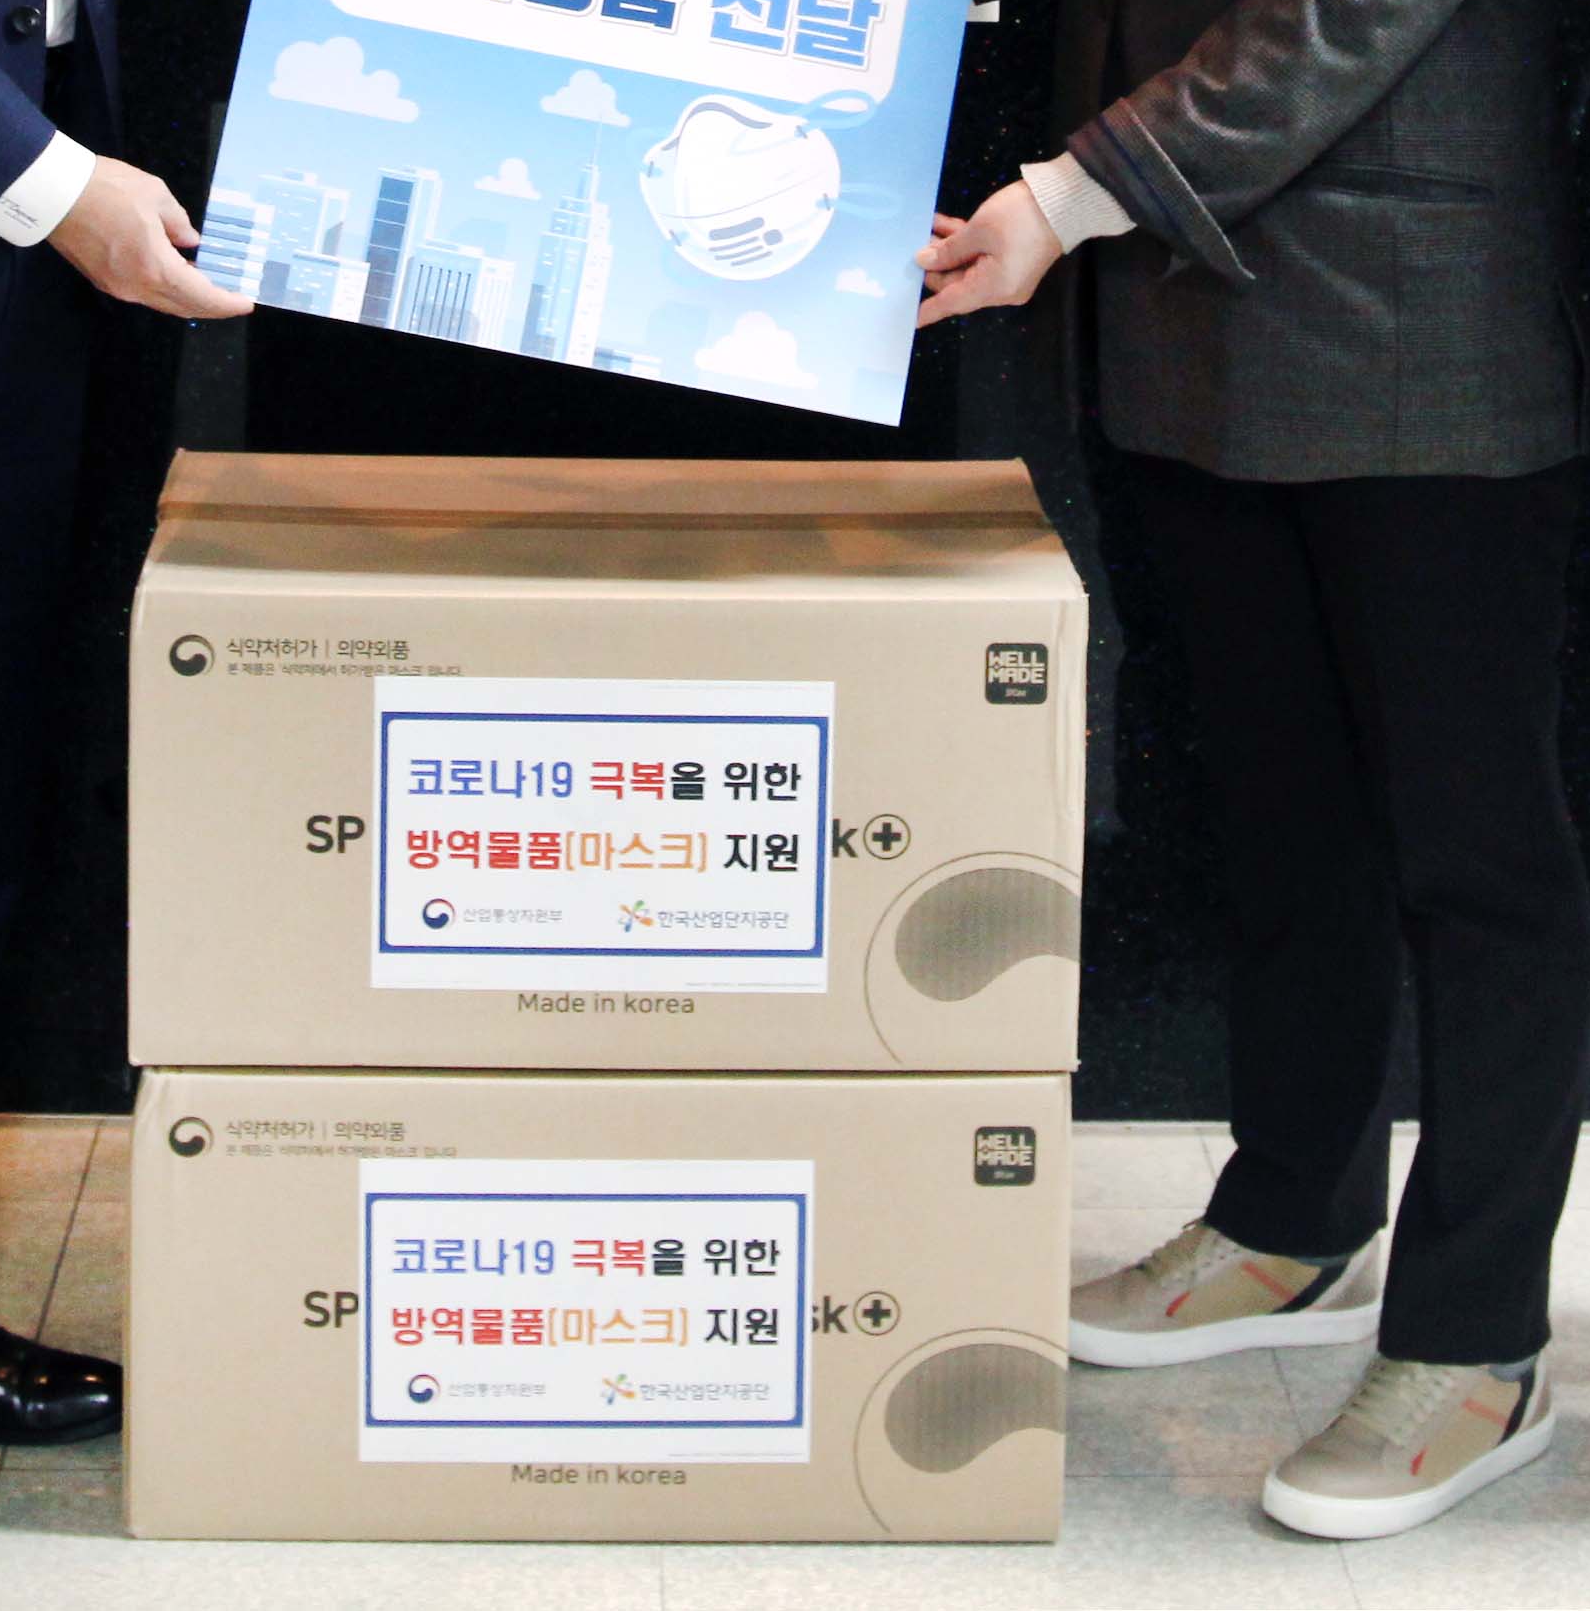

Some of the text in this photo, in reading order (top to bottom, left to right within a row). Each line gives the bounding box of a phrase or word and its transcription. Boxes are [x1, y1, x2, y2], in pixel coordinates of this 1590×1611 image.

[988, 650, 1046, 667] WELL
[988, 667, 1046, 684] MADE
[407, 759, 802, 802] 코로나19 극복을 위한
[723, 833, 800, 873] 지원
[656, 909, 790, 930] 한국산업단지공단
[517, 992, 696, 1014] Made in korea
[977, 1133, 1033, 1150] WELL
[977, 1150, 1034, 1166] MADE
[392, 1238, 781, 1277] 코로나19 극복을 위한
[704, 1307, 779, 1346] 지원
[511, 1464, 687, 1485] Made in korea
